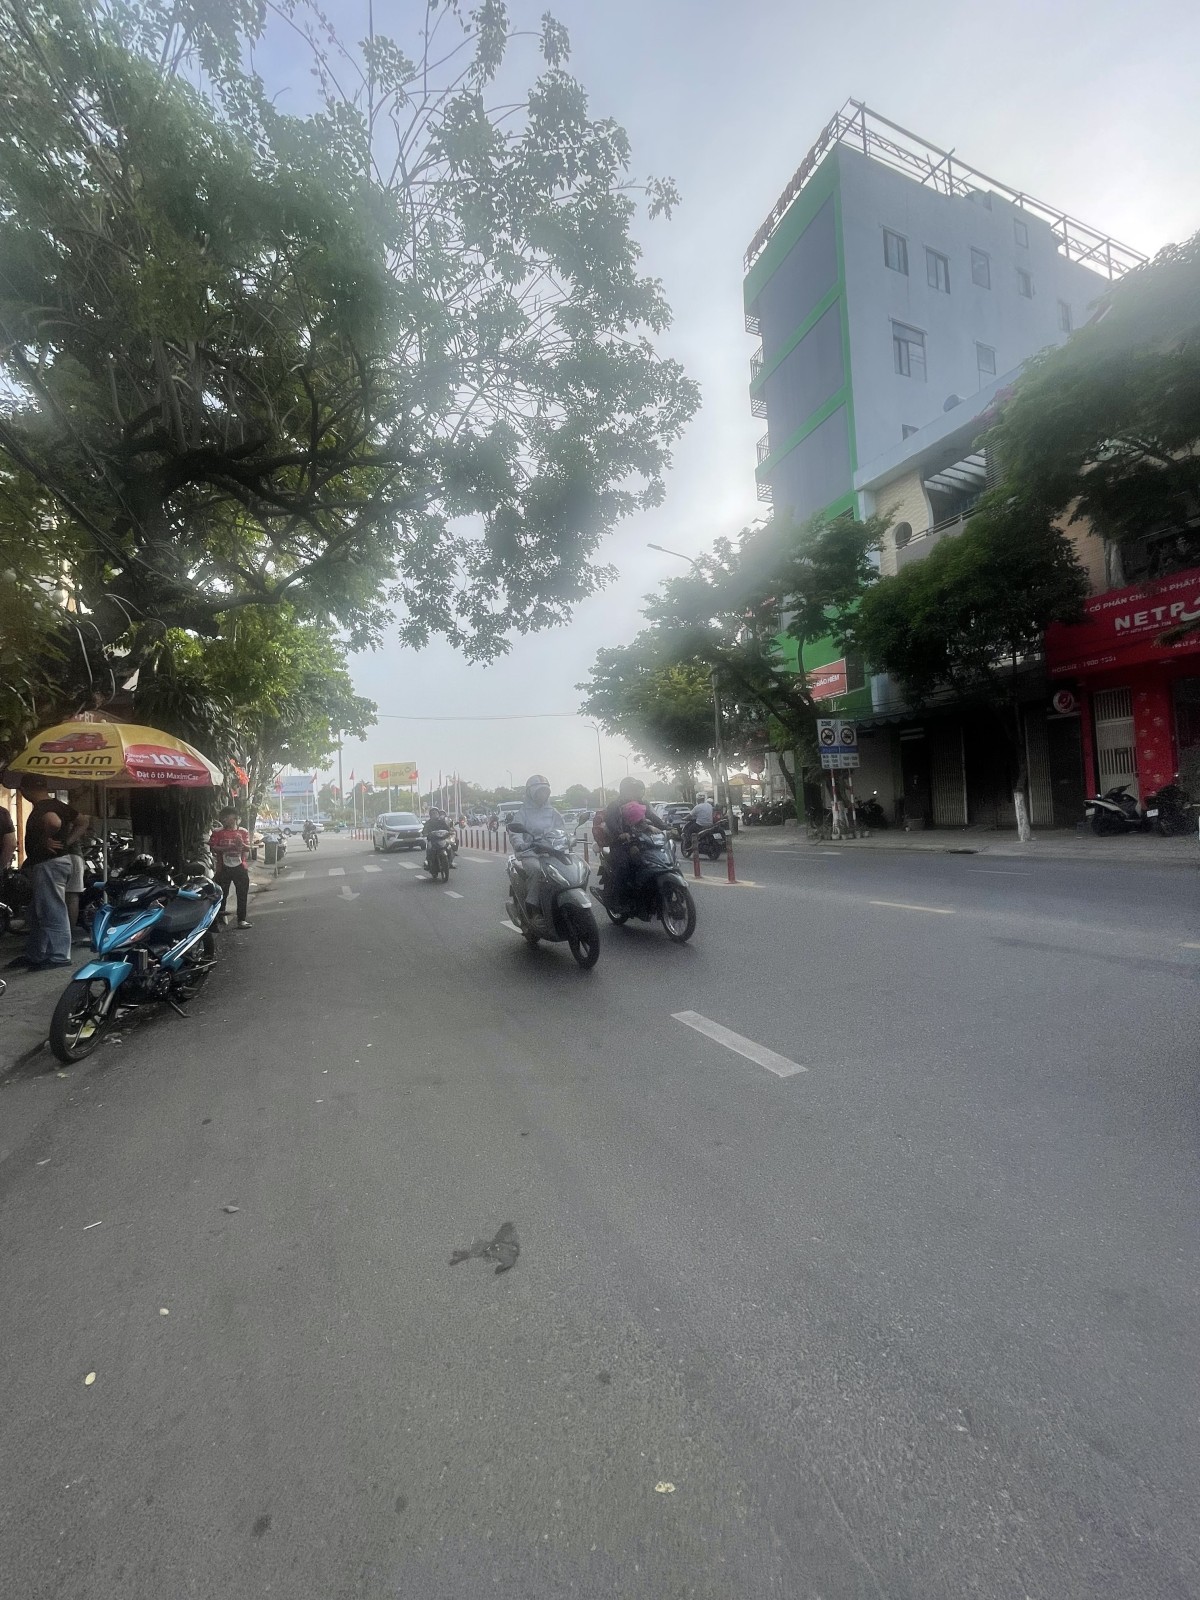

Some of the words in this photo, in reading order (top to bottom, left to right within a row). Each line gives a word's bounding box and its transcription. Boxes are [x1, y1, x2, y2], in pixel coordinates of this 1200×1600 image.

[26, 753, 113, 766] maxim
[150, 753, 192, 767] 10K
[166, 772, 199, 781] MaximCar
